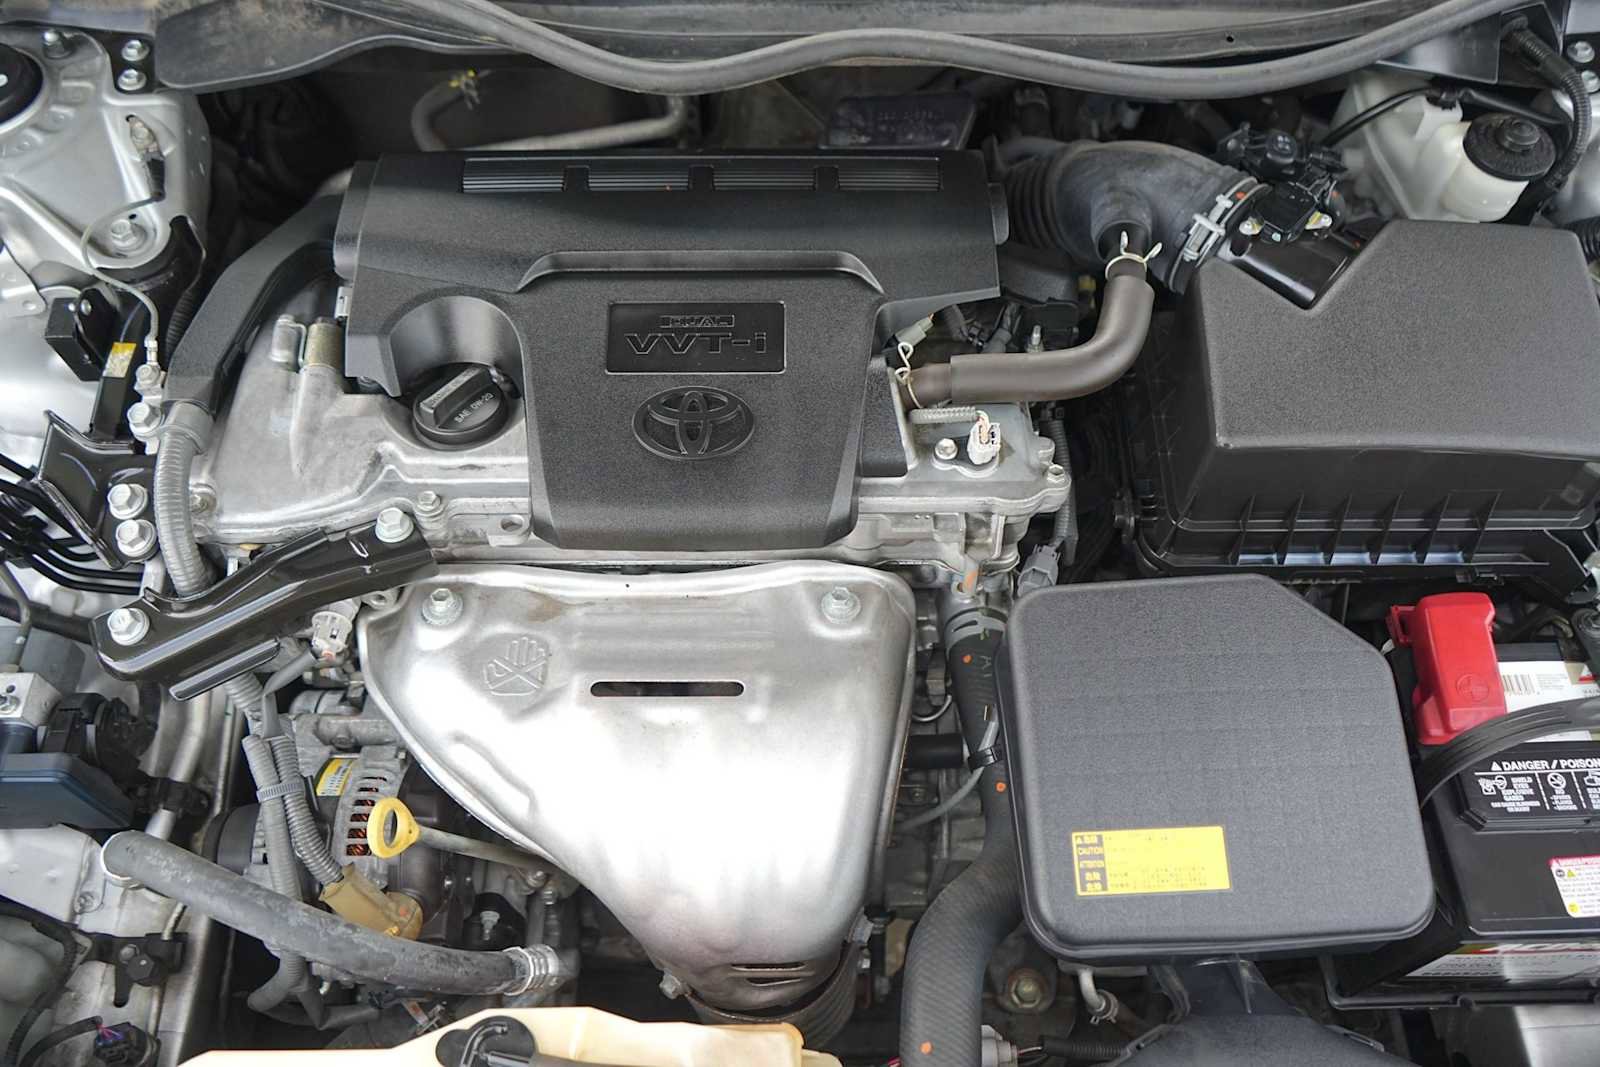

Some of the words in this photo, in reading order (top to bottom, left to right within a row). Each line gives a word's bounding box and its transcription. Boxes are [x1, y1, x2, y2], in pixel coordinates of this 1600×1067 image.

[624, 331, 767, 354] VVT-i
[454, 410, 472, 423] SAE
[1501, 760, 1550, 771] DANGER
[1560, 758, 1600, 769] POISON
